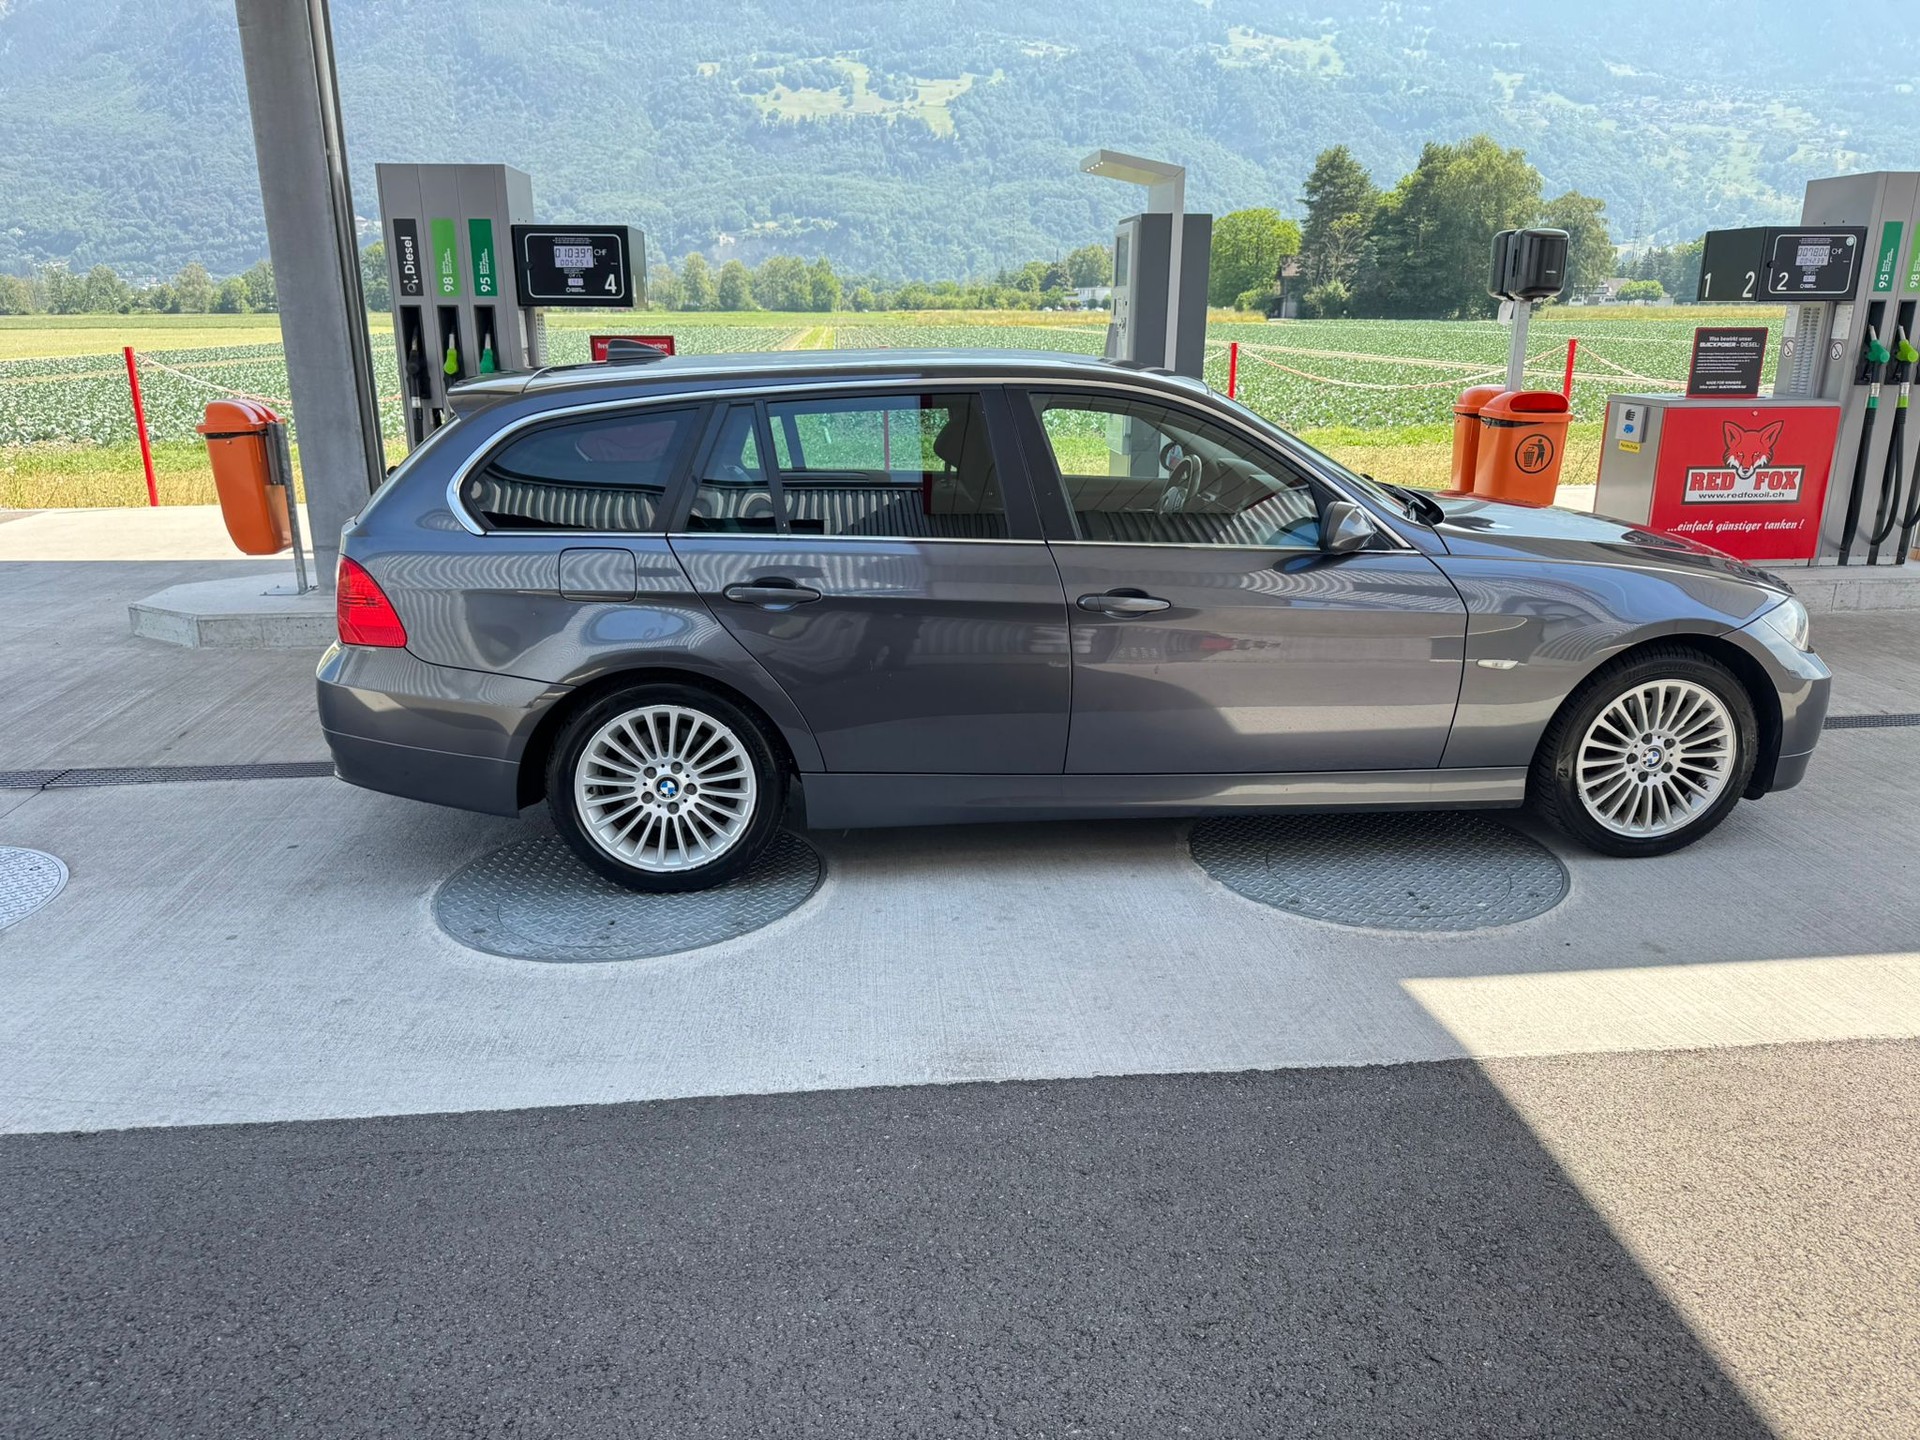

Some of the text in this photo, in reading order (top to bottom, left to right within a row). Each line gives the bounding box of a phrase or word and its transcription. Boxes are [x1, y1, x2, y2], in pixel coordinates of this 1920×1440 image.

[400, 236, 415, 274] Diesel
[443, 277, 454, 292] 98
[480, 277, 491, 292] 95
[604, 273, 617, 294] 4
[1704, 271, 1756, 298] 1 2
[1776, 272, 1789, 291] 2
[1879, 274, 1889, 288] 95
[1909, 273, 1920, 288] 98
[1688, 470, 1799, 491] RED FOX
[1698, 491, 1785, 499] www.redfoxoil.ch
[1716, 520, 1761, 533] günstiger
[1764, 519, 1797, 530] tanken
